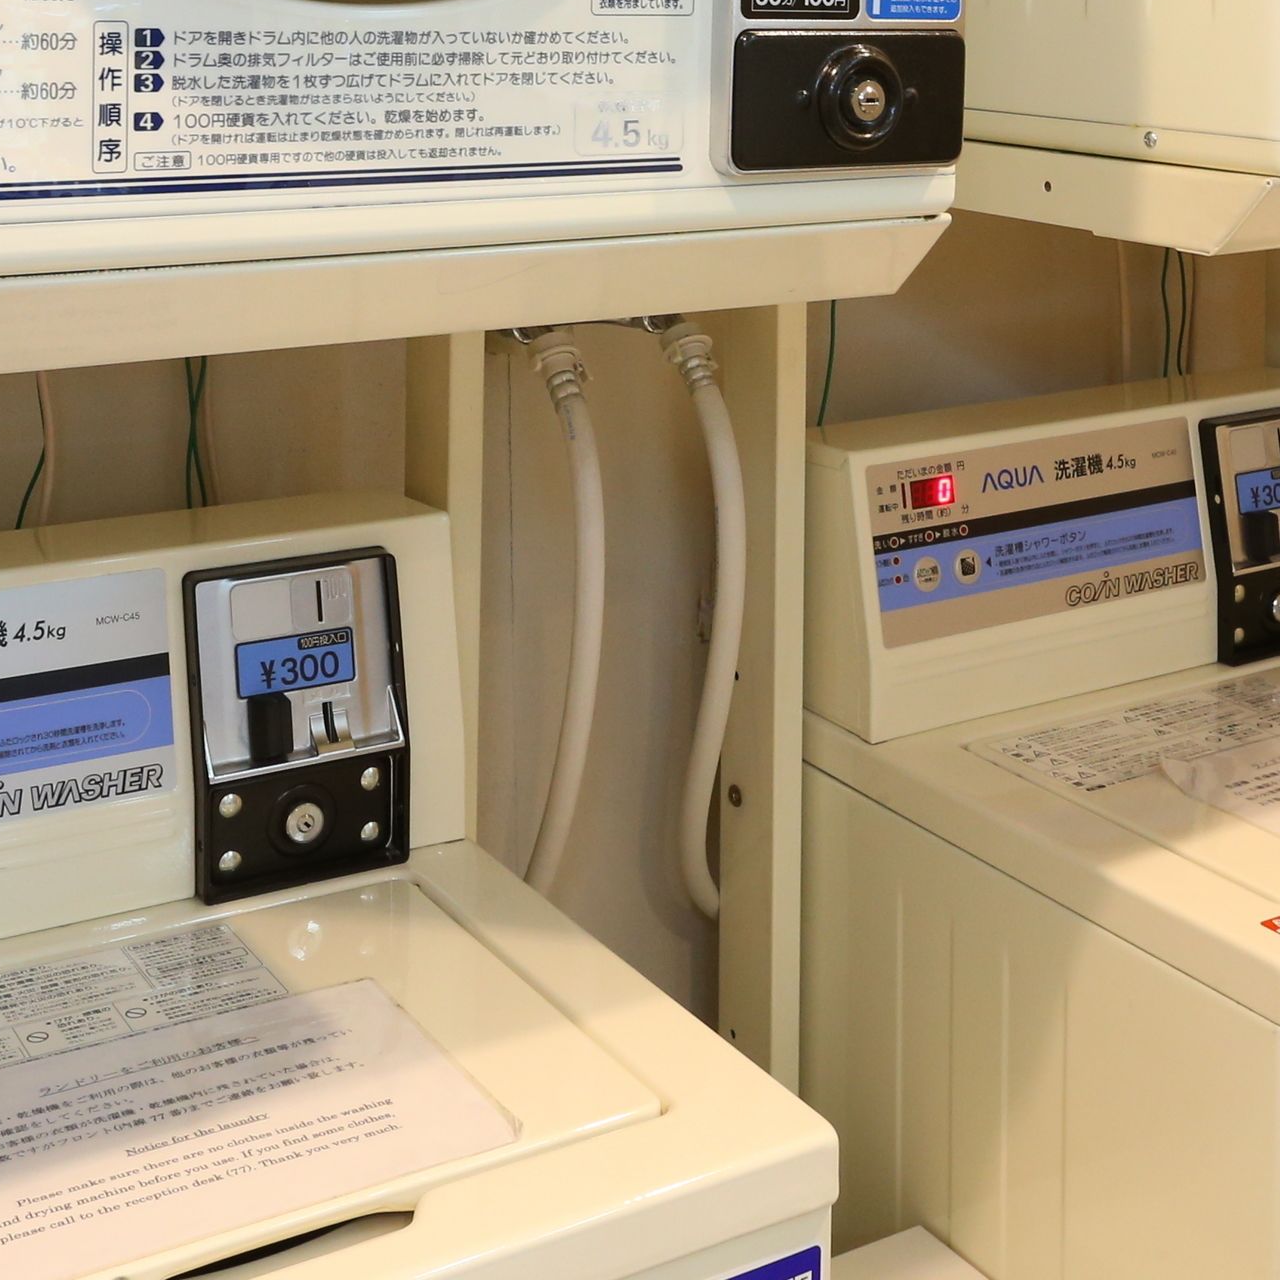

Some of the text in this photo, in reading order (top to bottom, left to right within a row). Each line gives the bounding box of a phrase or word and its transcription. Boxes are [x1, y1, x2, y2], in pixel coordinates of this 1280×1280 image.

[21, 32, 77, 51] 約60分
[21, 82, 77, 101] 約60分
[98, 31, 123, 163] 操作順序
[648, 129, 669, 150] kg
[141, 155, 185, 168] ご注意
[981, 454, 1136, 493] AQUA 洗濯機 4.5kg
[938, 478, 951, 503] 0
[1065, 561, 1199, 607] COIN WASHER
[12, 621, 67, 644] 4.5kg
[260, 650, 340, 689] ¥300
[30, 763, 163, 811] WASHER
[125, 1111, 270, 1158] Notice for the laundry
